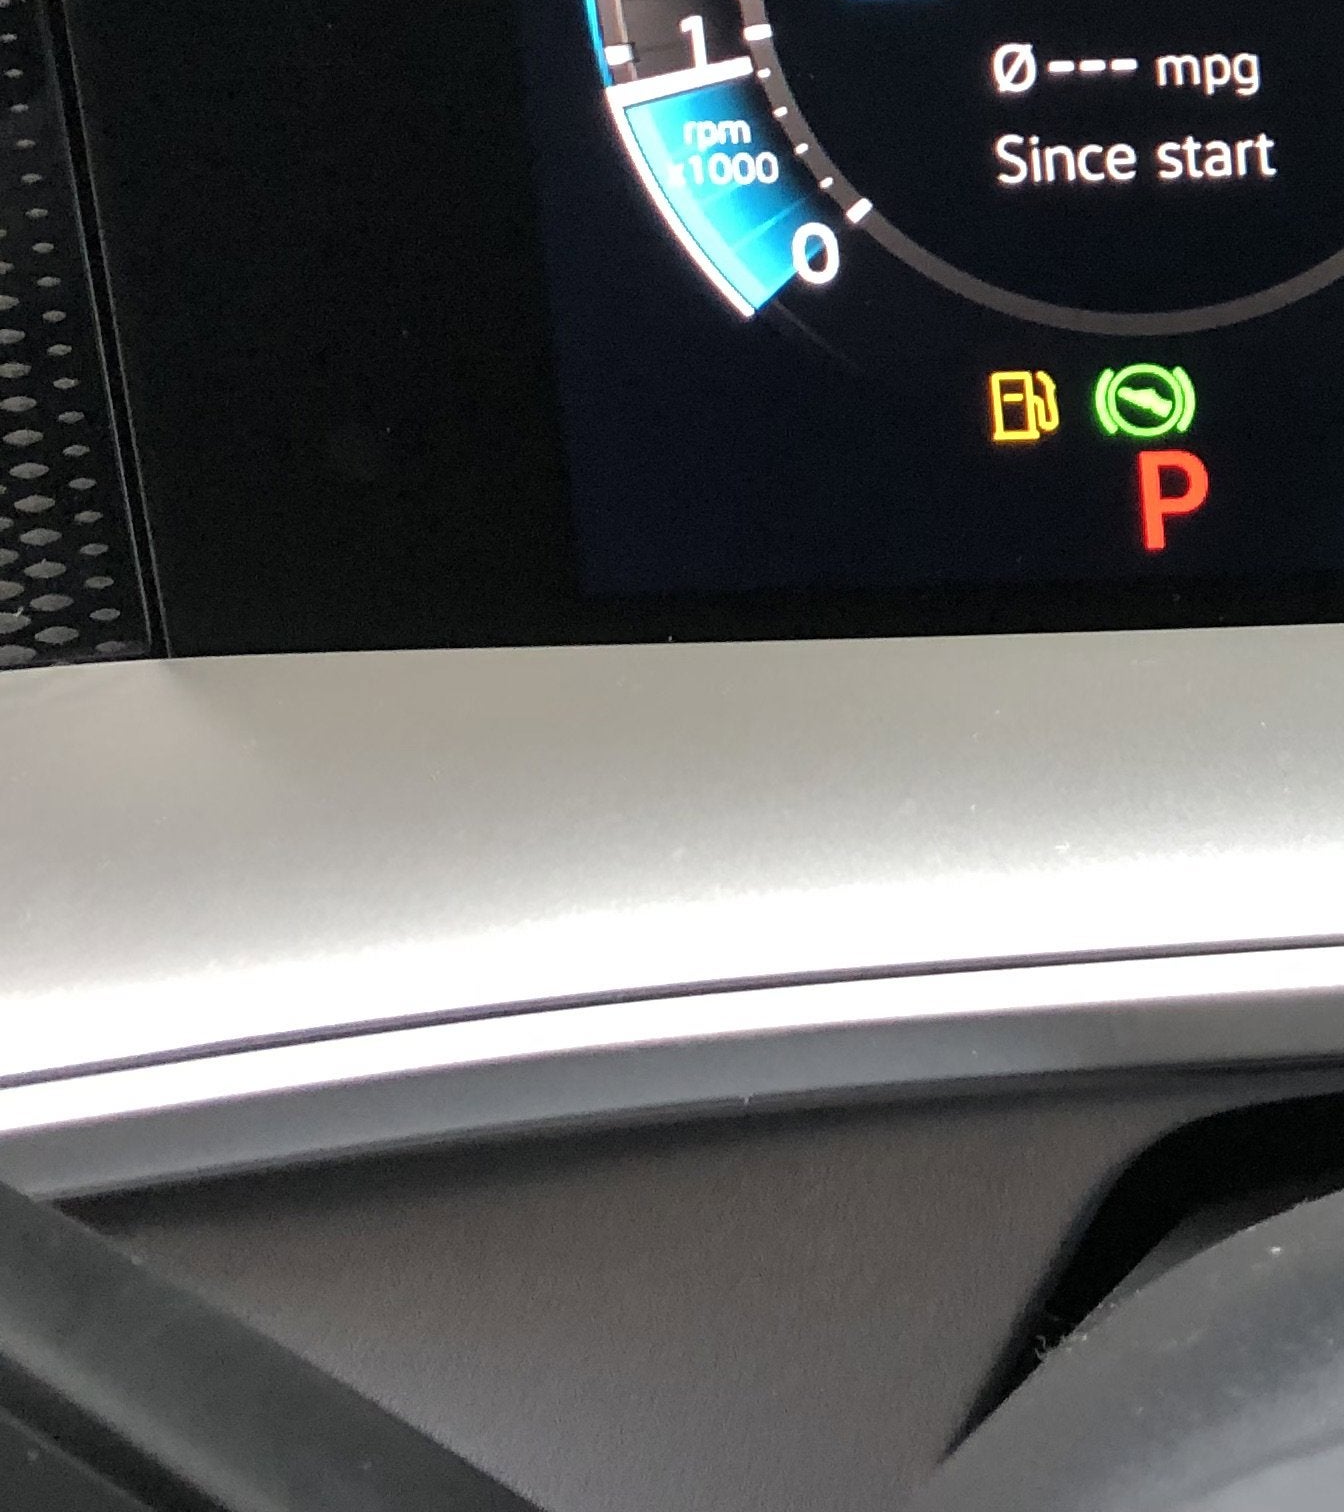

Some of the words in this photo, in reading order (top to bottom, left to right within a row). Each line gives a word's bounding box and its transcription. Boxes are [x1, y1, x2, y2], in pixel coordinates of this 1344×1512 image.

[679, 14, 708, 72] 1
[1154, 52, 1261, 97] mpg
[682, 119, 752, 152] rpm
[994, 133, 1137, 185] Since
[1156, 133, 1277, 180] start
[791, 221, 840, 285] 0
[1137, 449, 1209, 552] P
